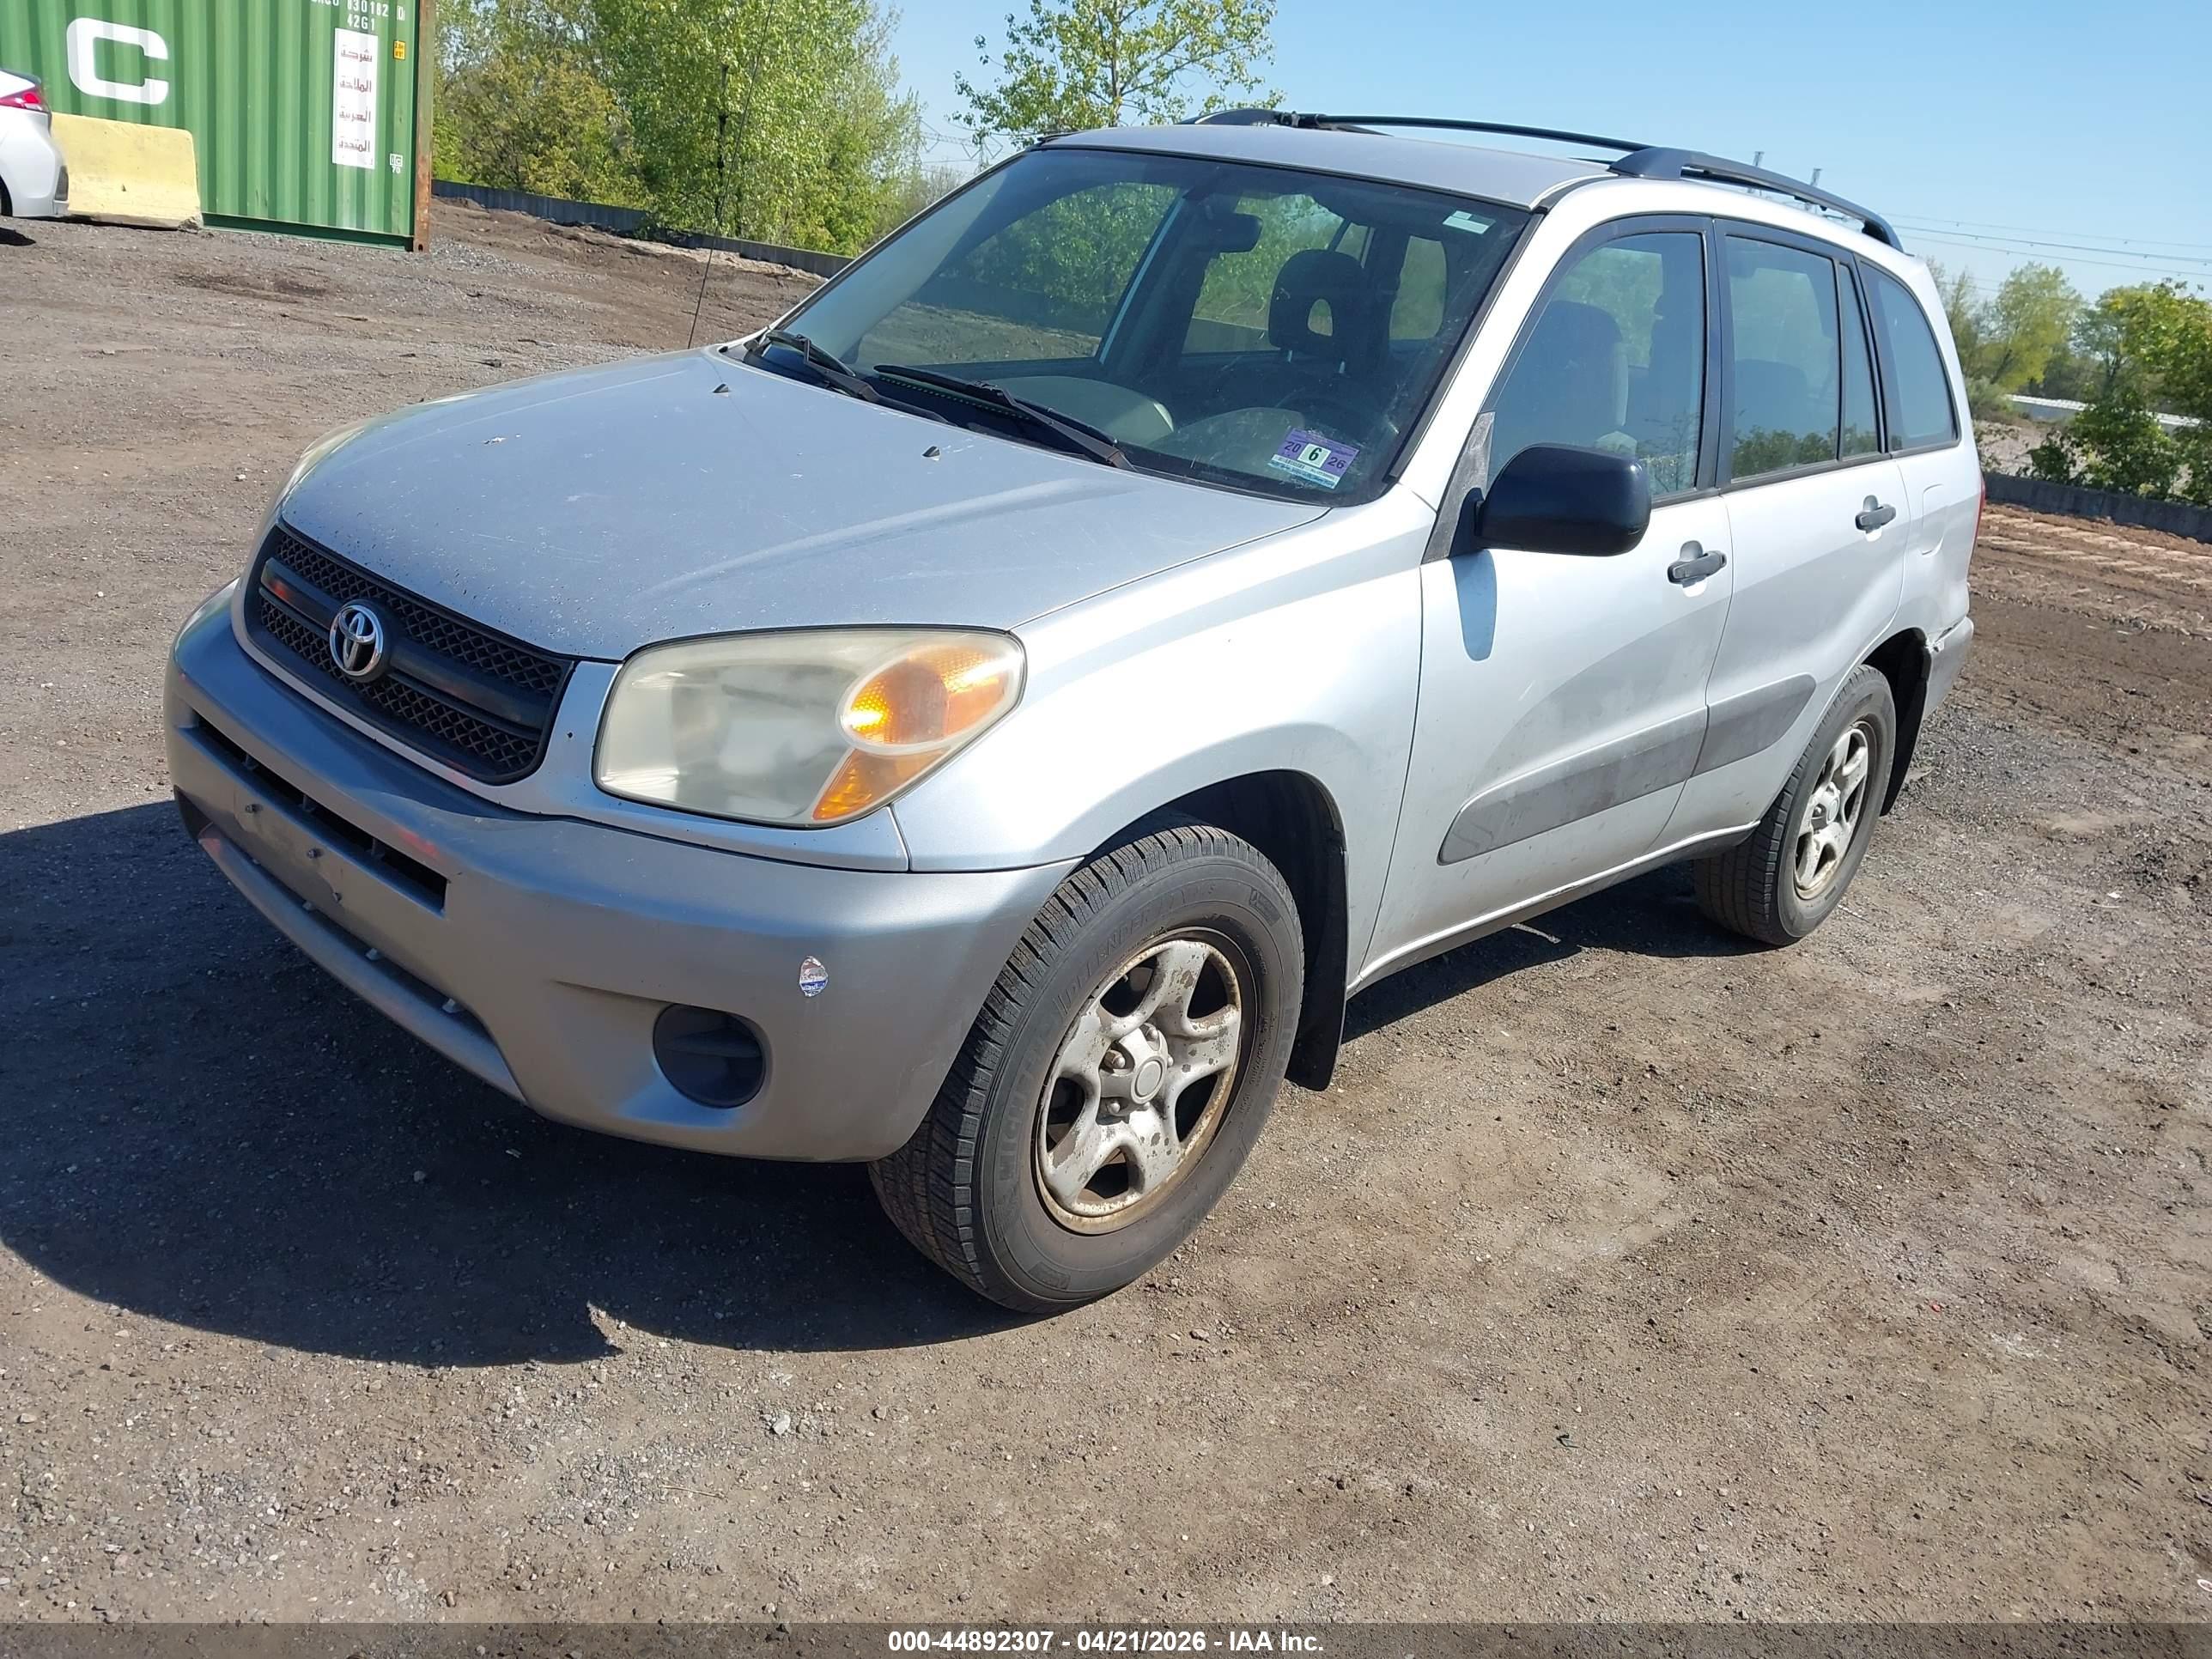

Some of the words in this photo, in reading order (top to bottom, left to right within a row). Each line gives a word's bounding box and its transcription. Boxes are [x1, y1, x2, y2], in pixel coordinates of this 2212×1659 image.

[347, 13, 375, 31] 42G1
[66, 17, 169, 105] C
[1284, 441, 1302, 453] 20
[1308, 447, 1322, 461] 6
[1328, 456, 1346, 469] 26
